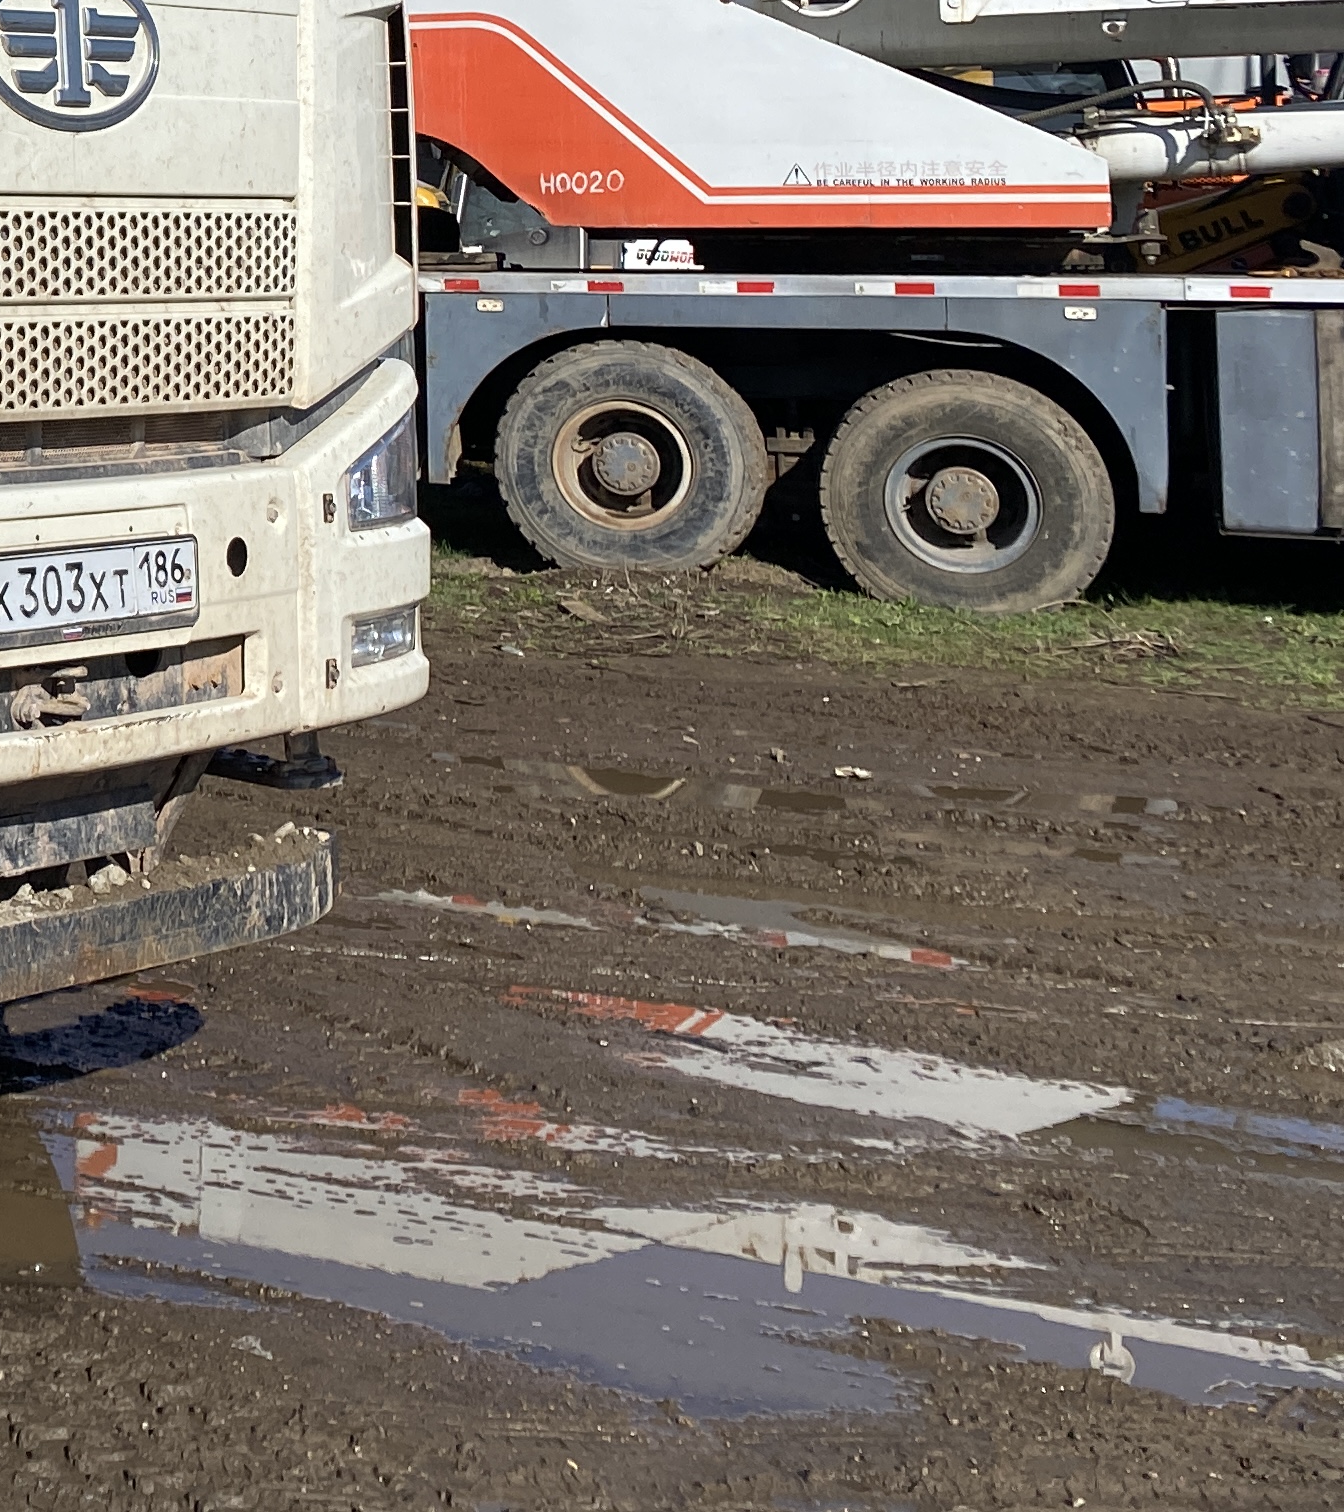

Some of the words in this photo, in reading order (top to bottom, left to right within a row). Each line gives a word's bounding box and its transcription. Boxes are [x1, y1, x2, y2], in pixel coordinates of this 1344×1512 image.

[816, 178, 829, 187] BE
[832, 178, 874, 187] CAREFUL
[880, 178, 890, 187] IN
[896, 178, 914, 187] THE
[920, 178, 966, 186] WORKING
[971, 177, 1007, 186] RADIUS
[1178, 209, 1265, 251] BULL
[138, 548, 185, 589] 186
[151, 589, 175, 605] RUS
